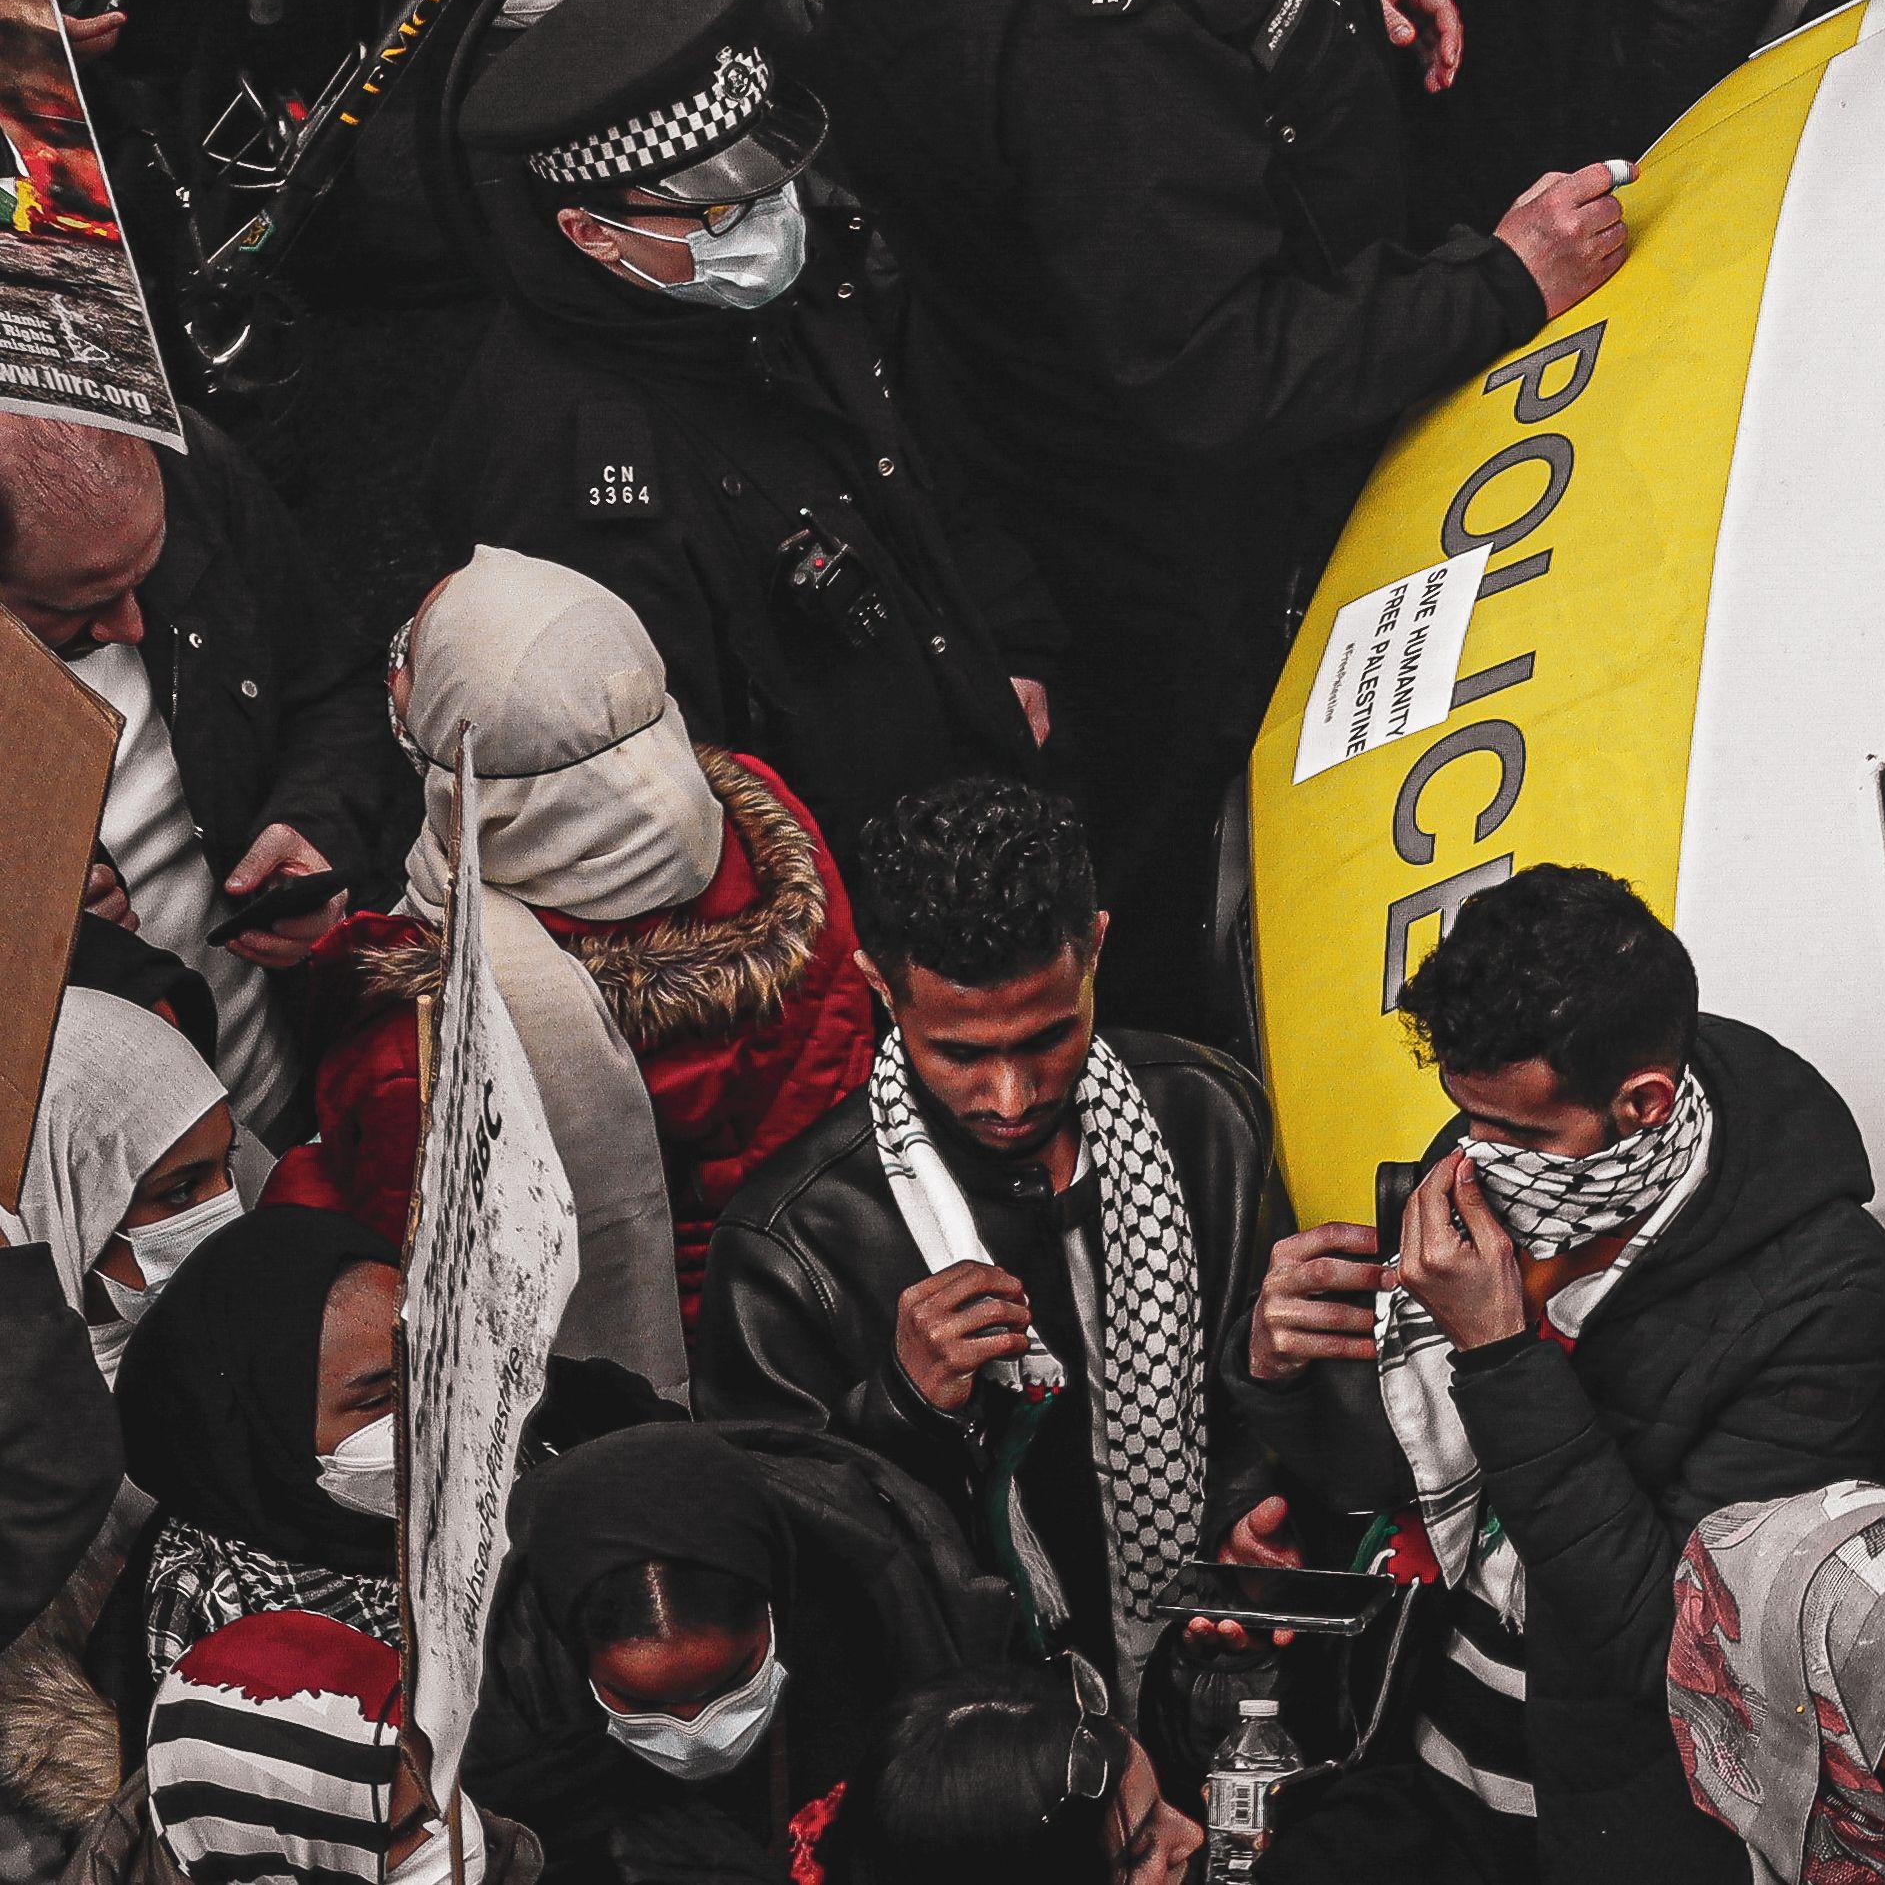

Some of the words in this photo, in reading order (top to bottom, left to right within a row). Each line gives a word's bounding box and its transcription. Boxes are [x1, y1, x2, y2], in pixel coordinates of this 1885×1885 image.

[3, 323, 56, 344] Rights
[589, 486, 650, 506] 3364
[603, 466, 633, 483] CN
[1374, 583, 1409, 637] FREE
[1413, 568, 1448, 622] SAVE
[1345, 639, 1391, 758] PALESTINE
[1386, 625, 1430, 737] HUMANITY
[470, 1078, 502, 1214] BBC
